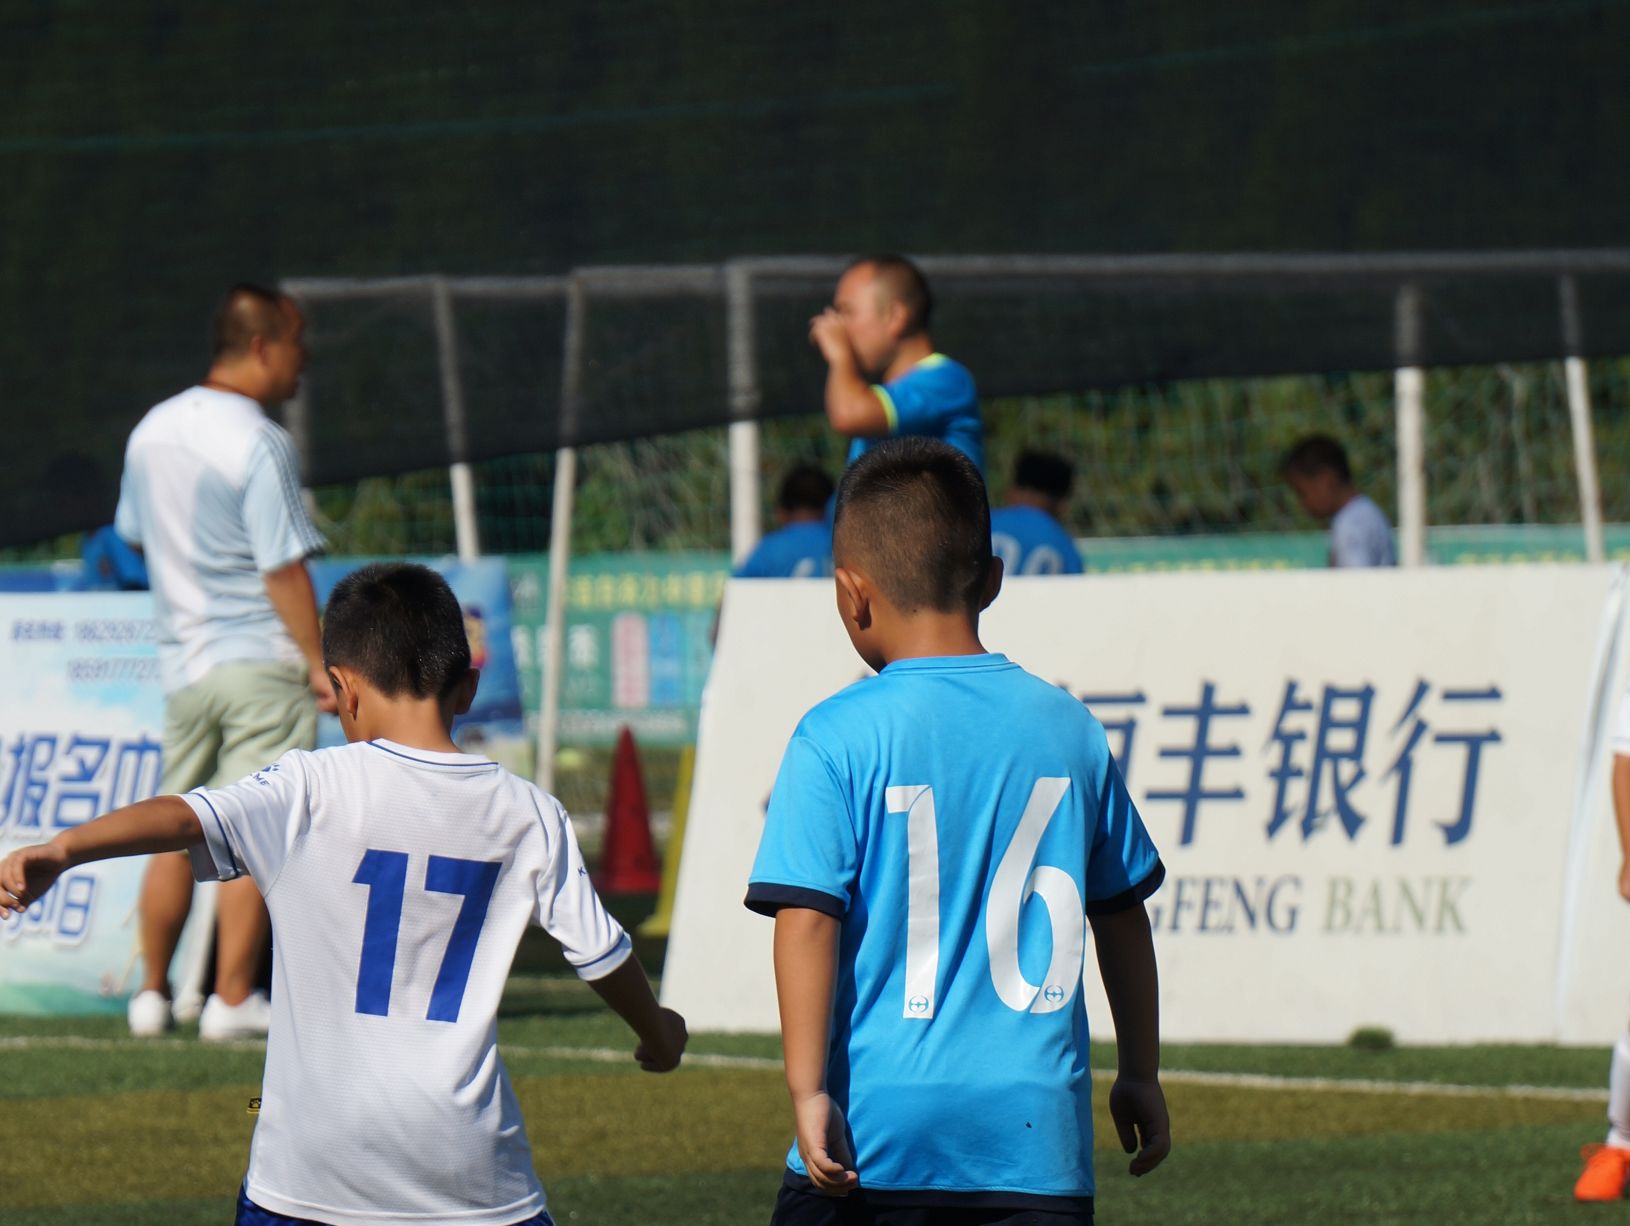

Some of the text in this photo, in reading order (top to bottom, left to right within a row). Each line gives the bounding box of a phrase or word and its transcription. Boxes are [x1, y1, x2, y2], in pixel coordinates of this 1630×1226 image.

[352, 848, 503, 1024] 17
[885, 776, 1085, 1019] 16
[1321, 876, 1470, 936] BANK
